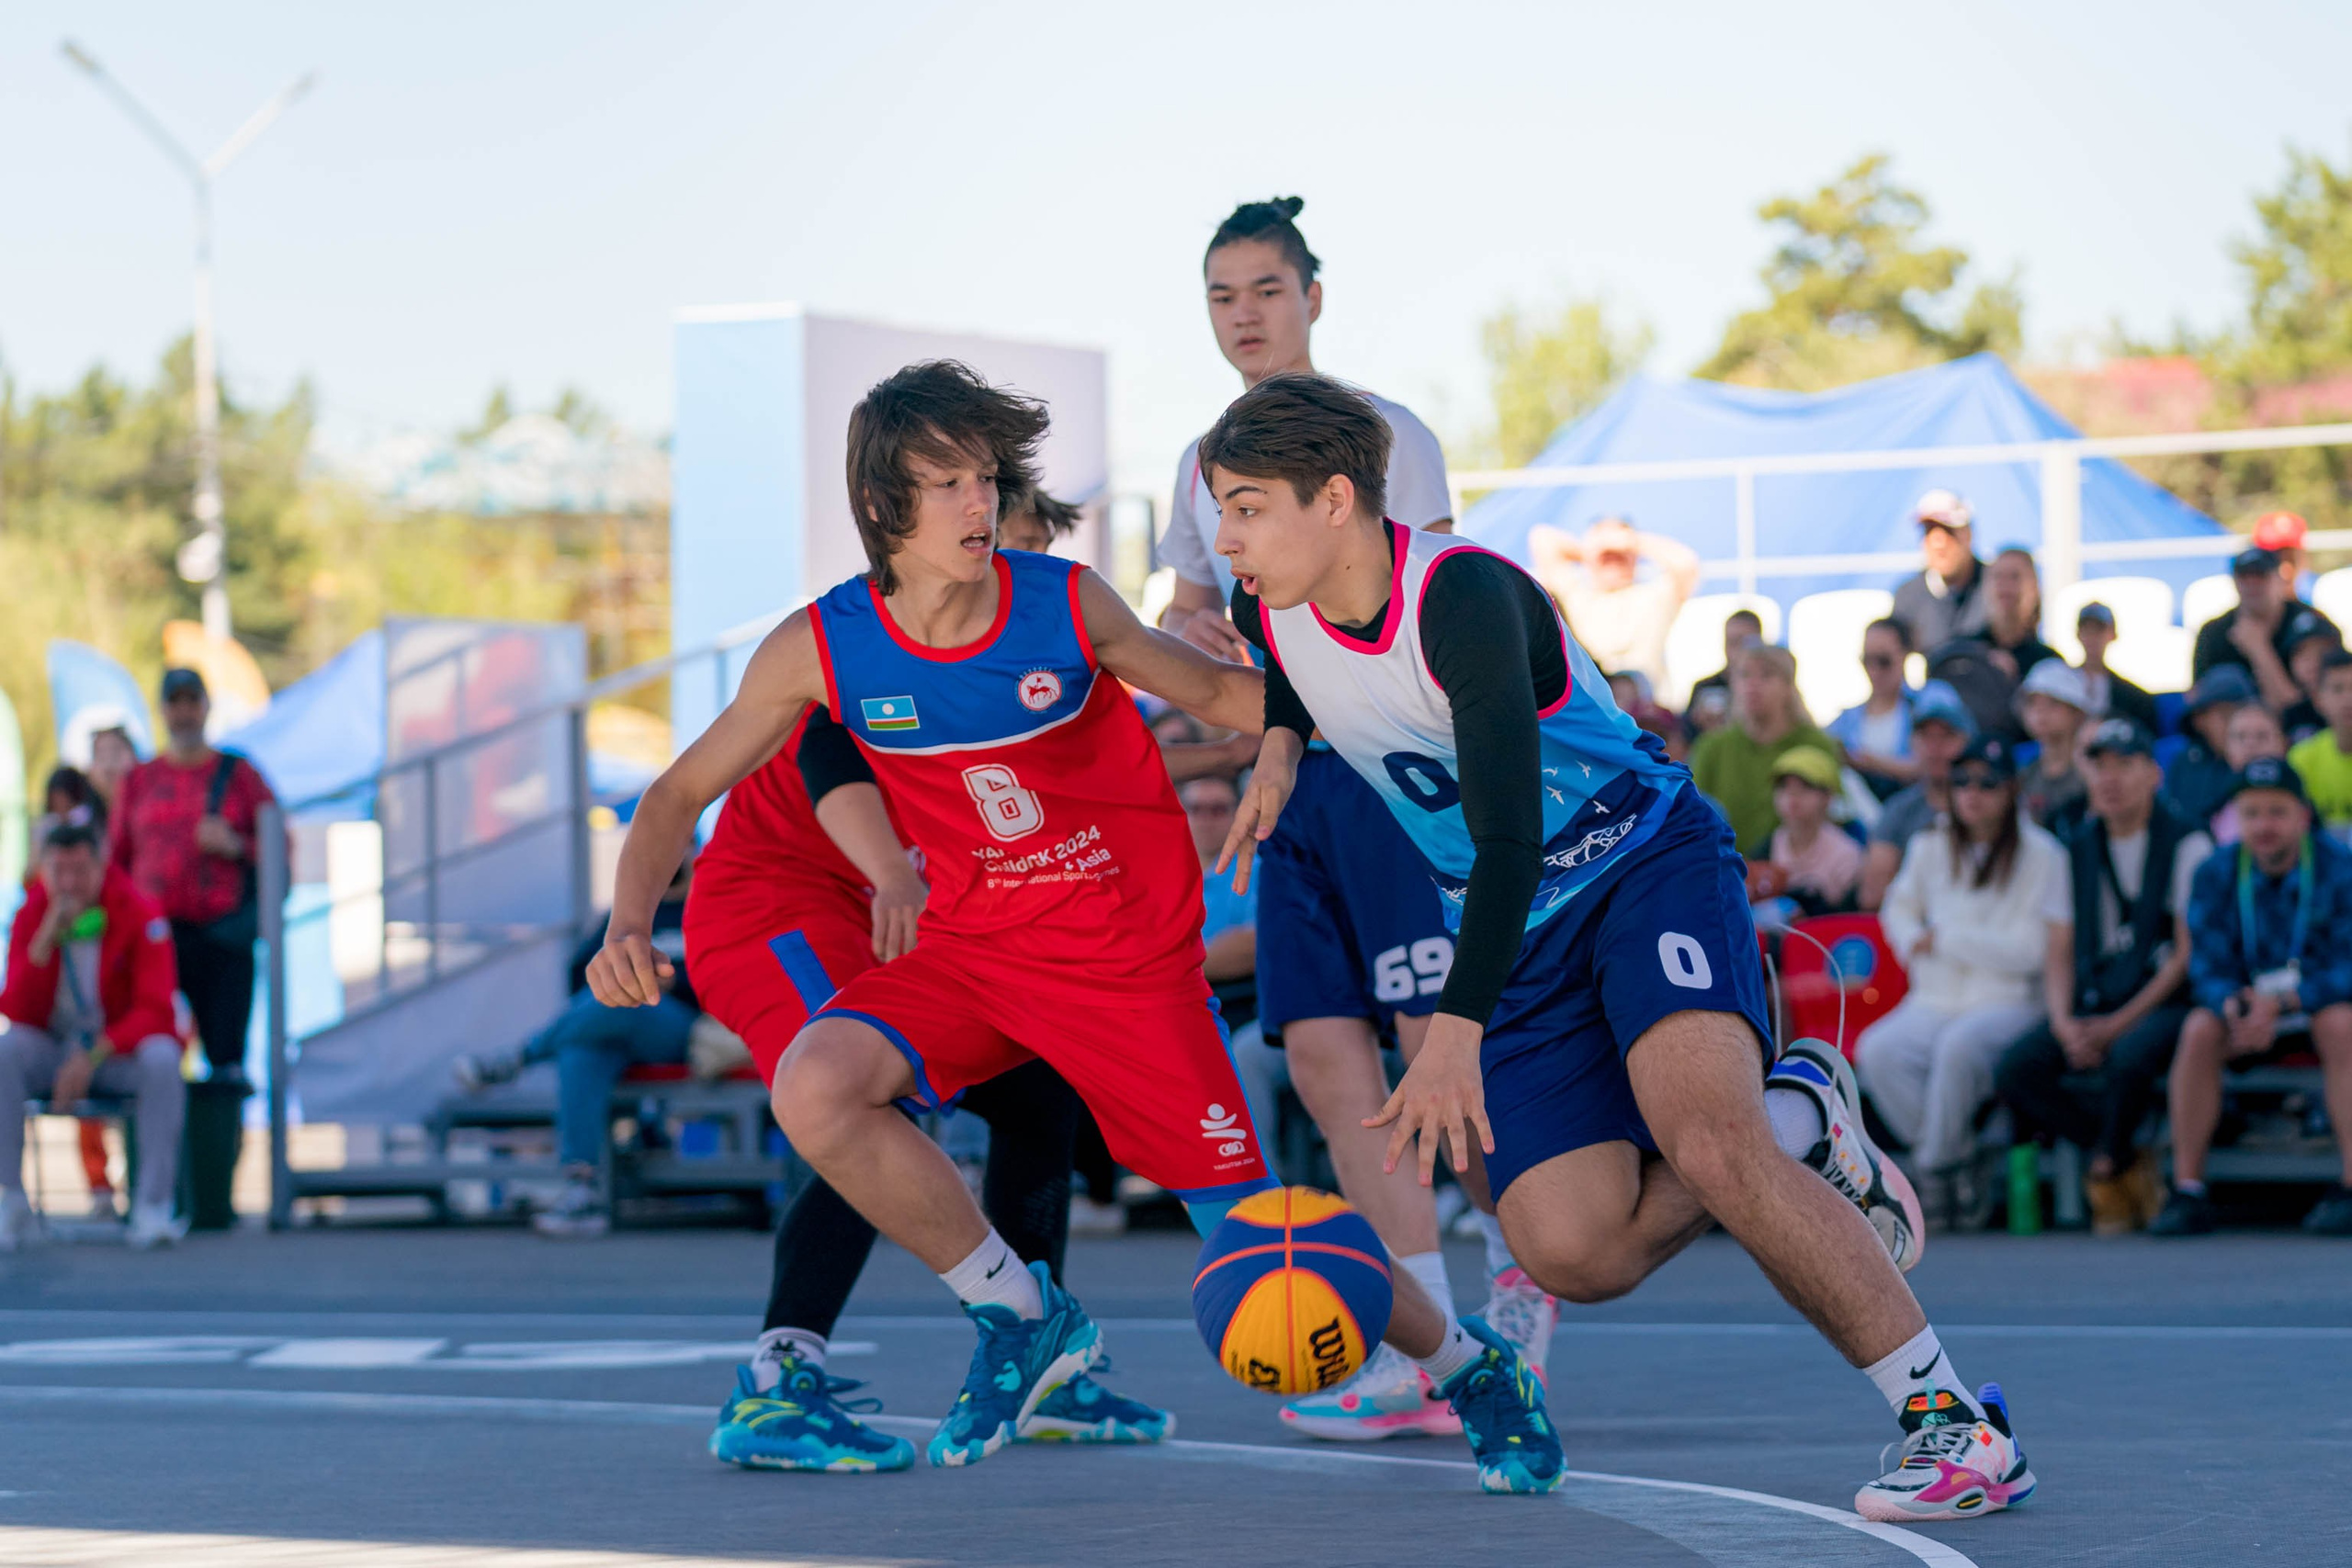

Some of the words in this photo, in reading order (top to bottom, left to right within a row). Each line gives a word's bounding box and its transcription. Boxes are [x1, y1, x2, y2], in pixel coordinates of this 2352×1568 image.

[1054, 825, 1101, 860] 2024
[1076, 847, 1112, 872] Asia
[1374, 936, 1454, 1002] 69
